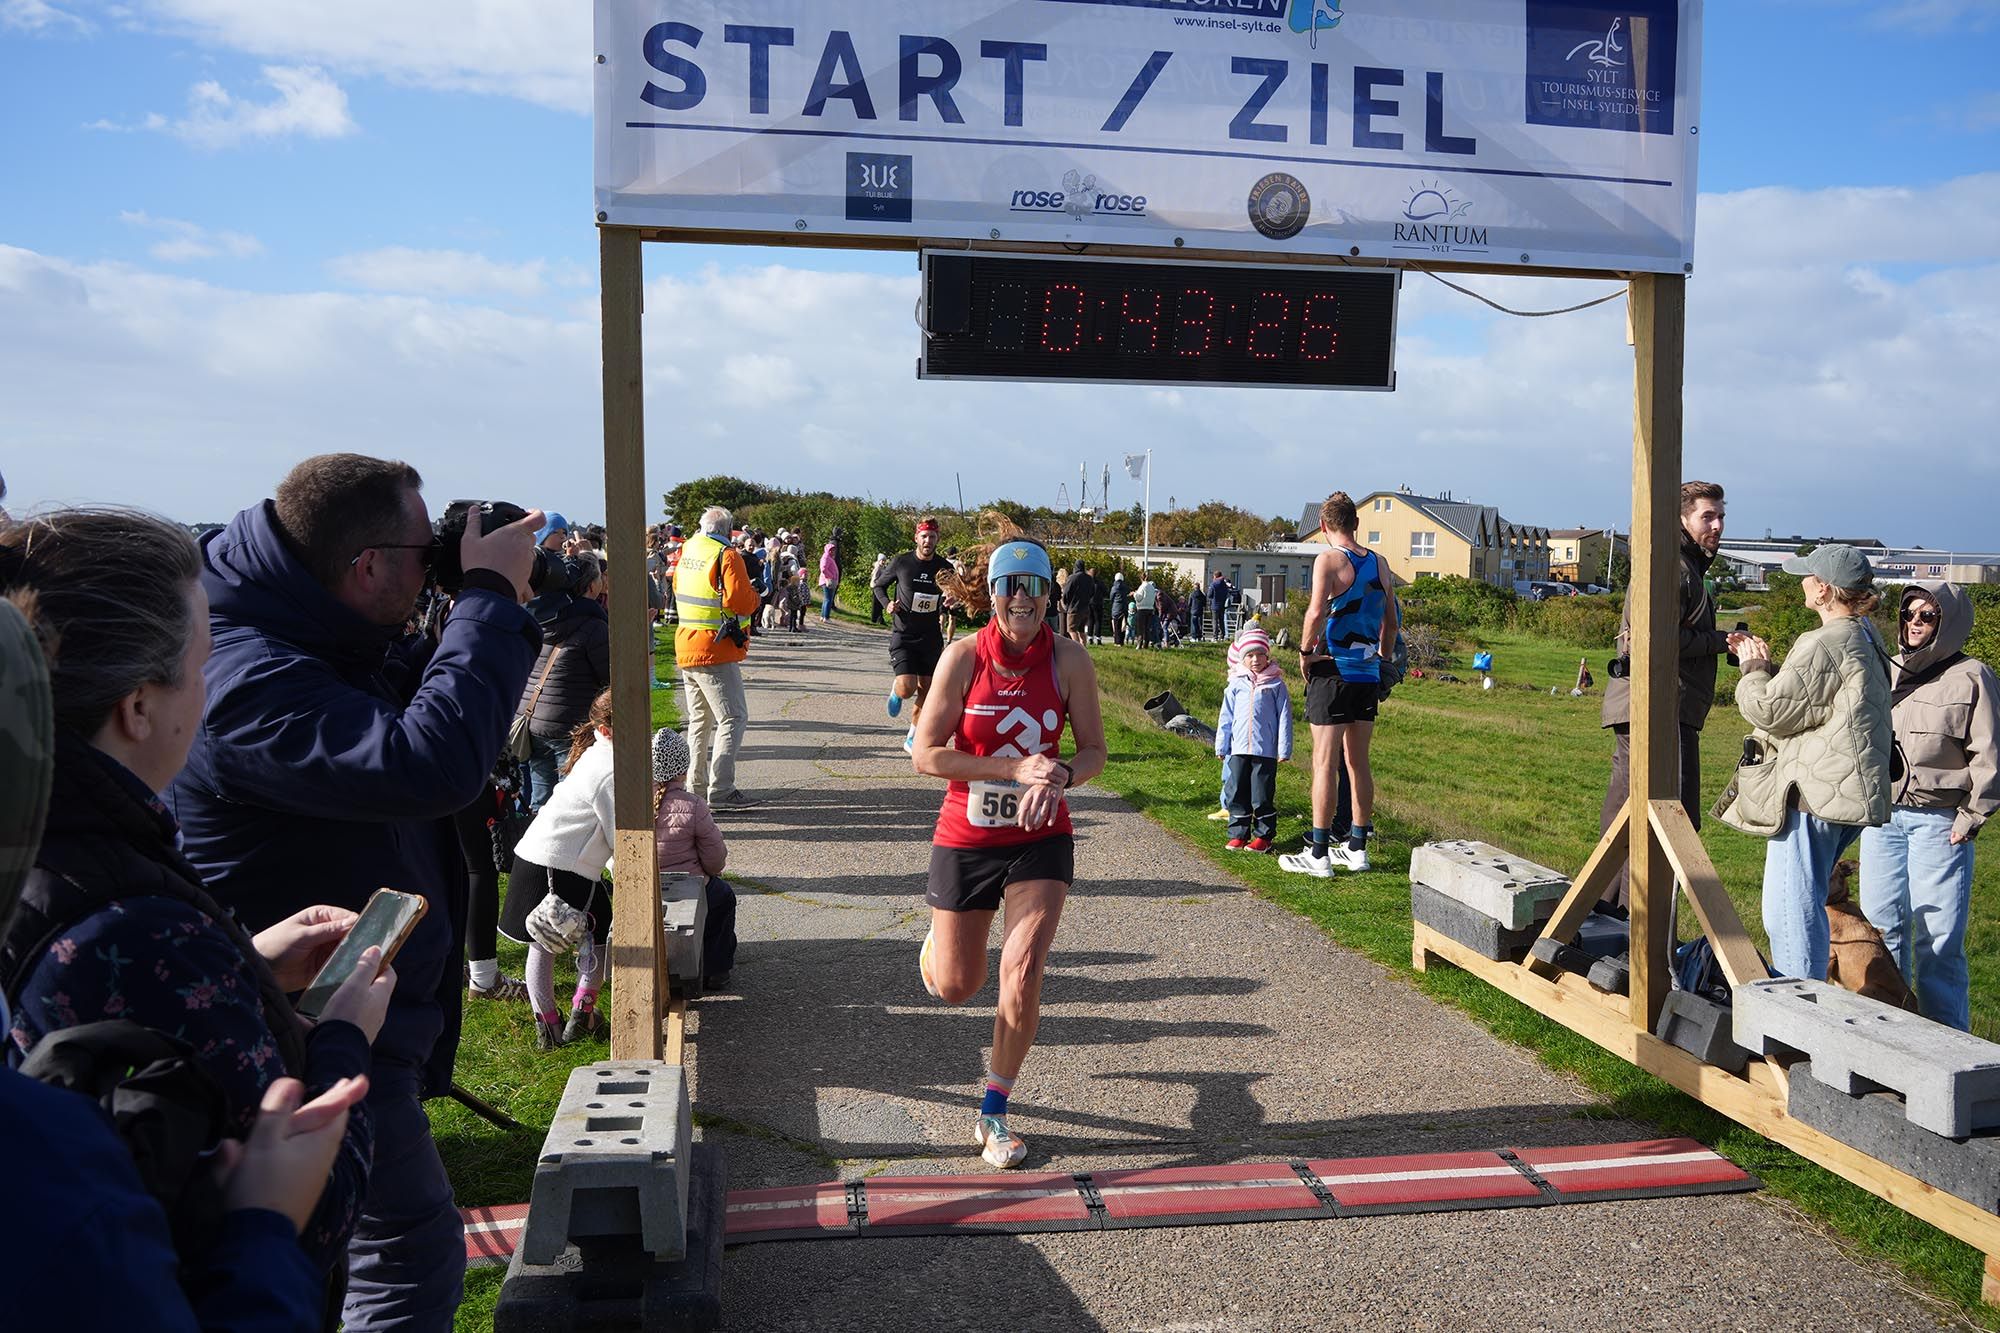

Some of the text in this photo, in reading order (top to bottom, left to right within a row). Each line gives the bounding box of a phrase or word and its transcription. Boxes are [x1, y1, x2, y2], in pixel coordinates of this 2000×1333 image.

[1174, 17, 1281, 33] www.insel-sylt.de
[1586, 69, 1619, 84] SYLT
[639, 21, 1048, 127] START
[1100, 51, 1174, 132] /
[1229, 56, 1476, 155] ZIEL
[1542, 81, 1660, 102] TOURISMUS-SERVICE
[1562, 99, 1640, 115] INSEL-SYLT.DE
[1011, 190, 1147, 212] rose rose
[1393, 222, 1489, 246] RANTUM
[1431, 245, 1451, 253] SYLT
[1041, 284, 1339, 360] 0:43:26
[918, 600, 931, 610] 46
[982, 791, 1018, 819] 56
